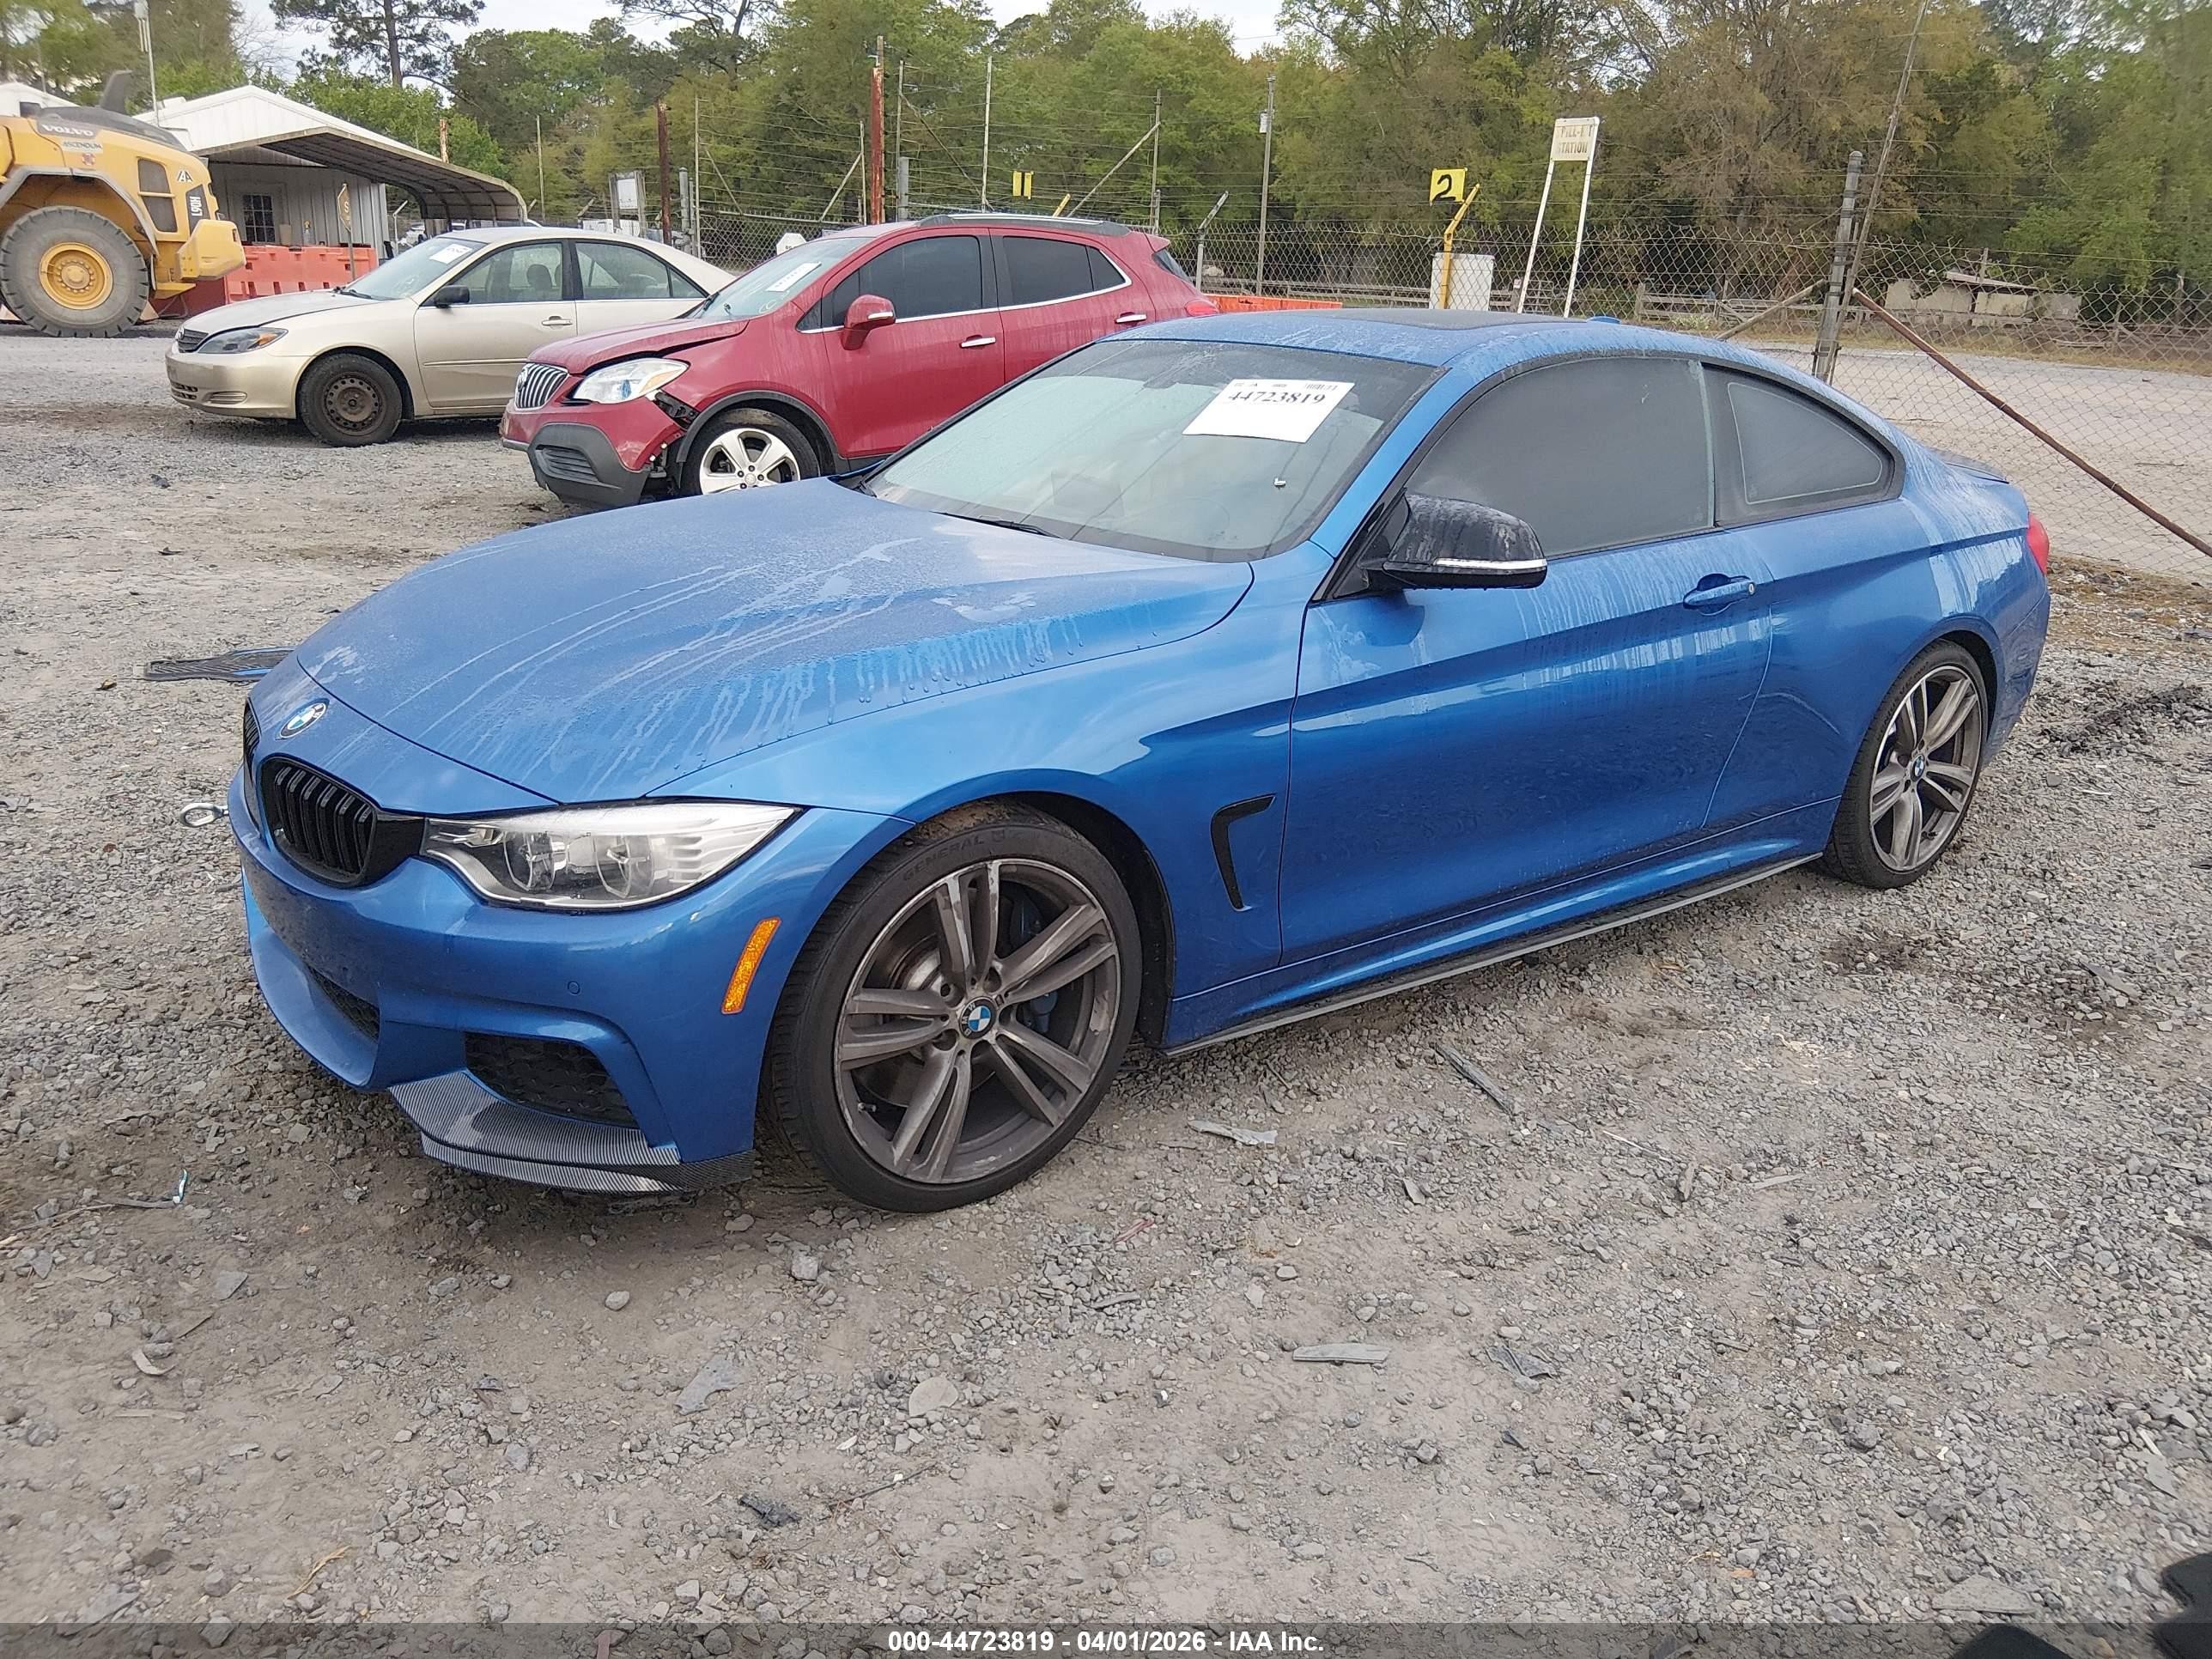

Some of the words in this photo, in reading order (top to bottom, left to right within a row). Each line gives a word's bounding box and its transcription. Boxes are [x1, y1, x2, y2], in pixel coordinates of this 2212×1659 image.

[41, 124, 94, 137] VOLVO
[1559, 142, 1589, 154] STATION
[1432, 173, 1457, 202] 2
[189, 196, 203, 216] L90H
[1228, 391, 1326, 404] 44723819
[904, 835, 984, 881] GENERAL
